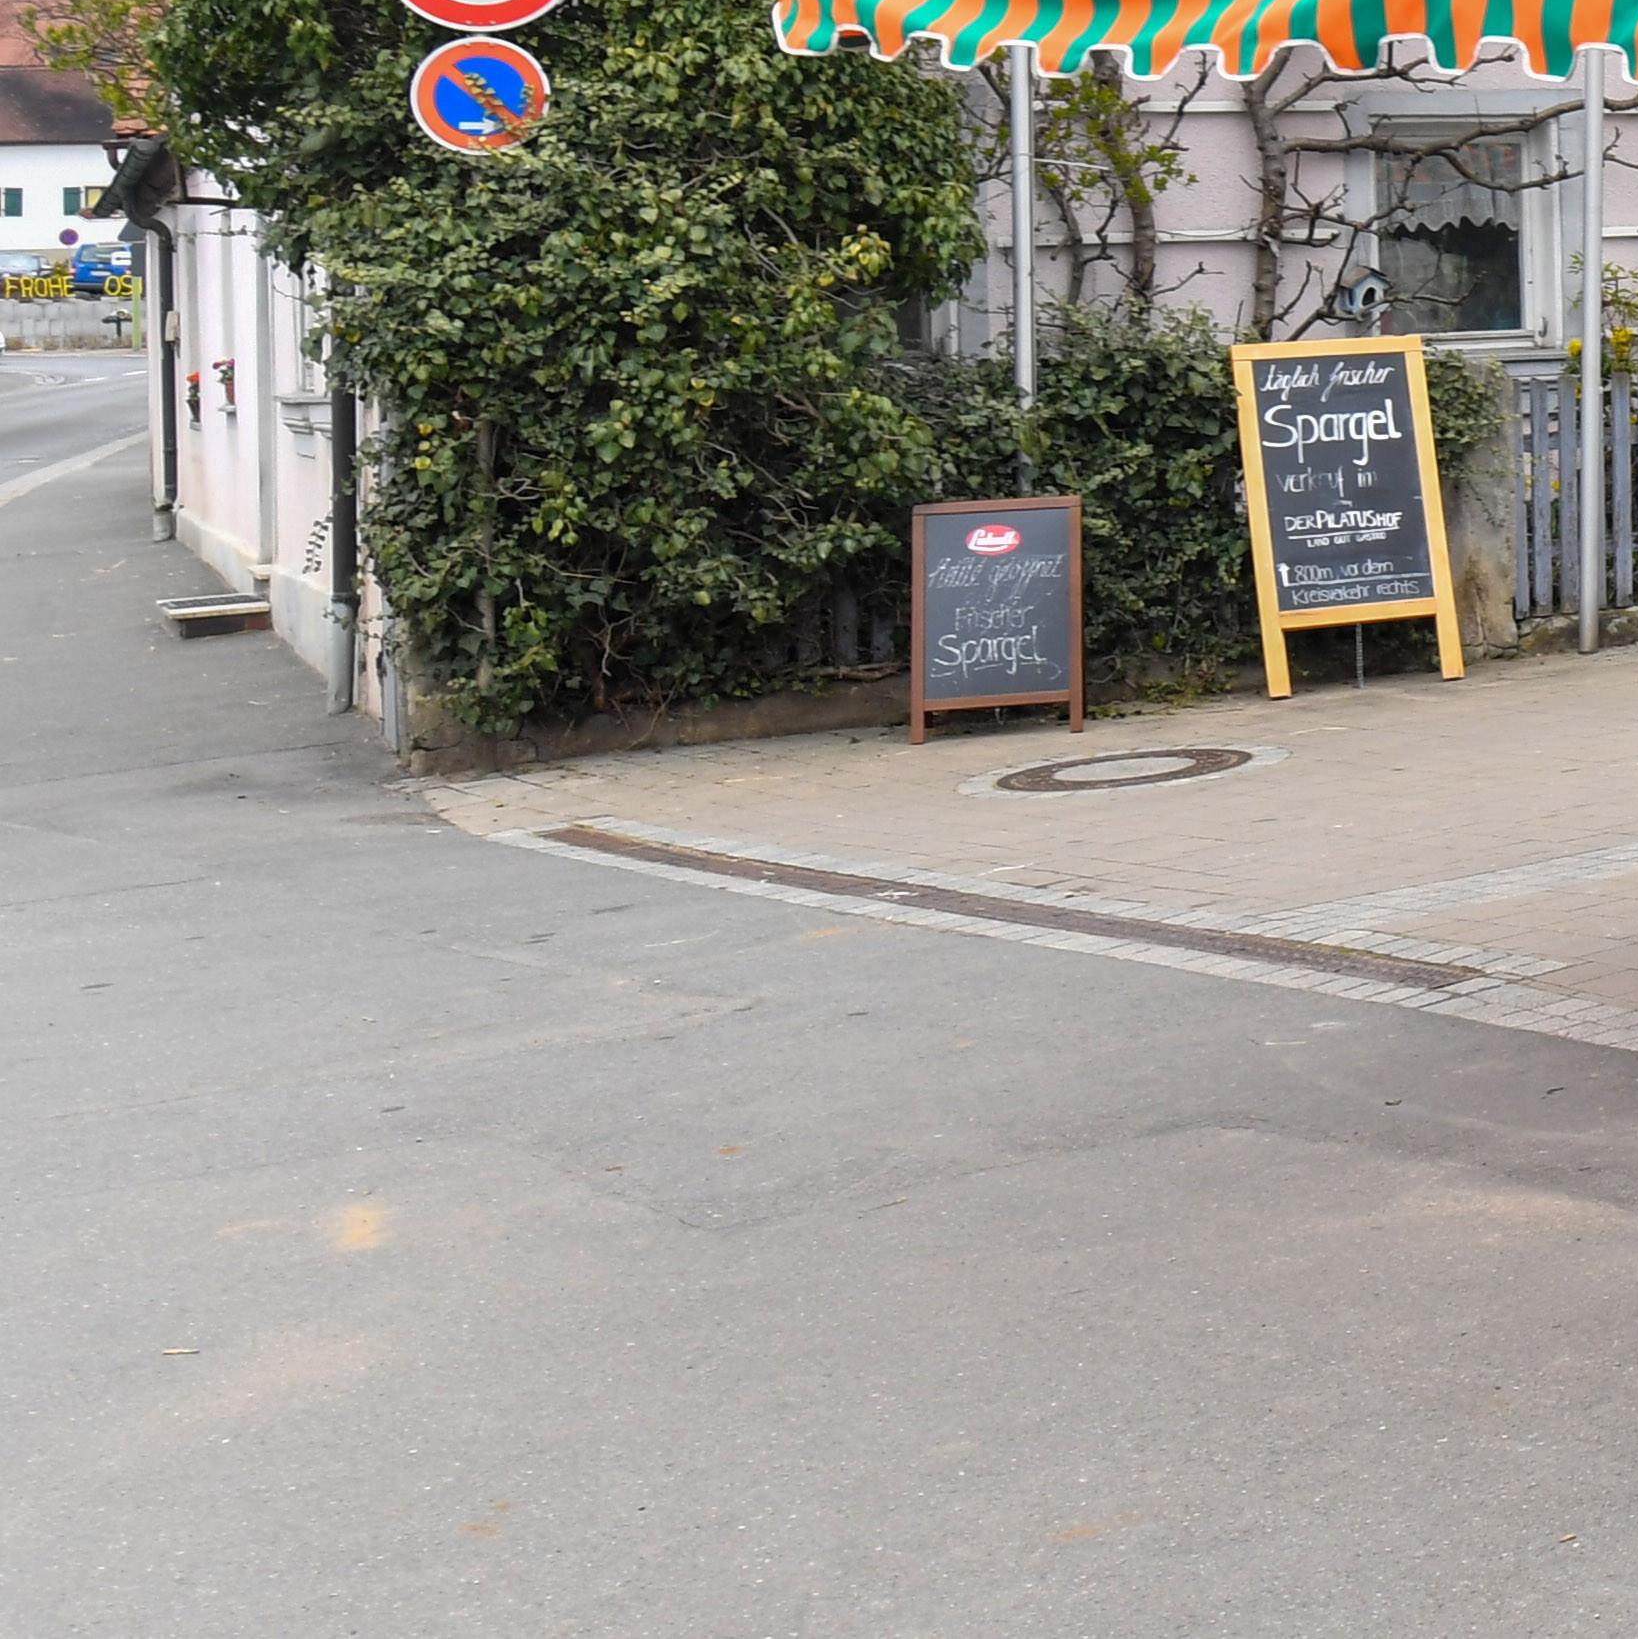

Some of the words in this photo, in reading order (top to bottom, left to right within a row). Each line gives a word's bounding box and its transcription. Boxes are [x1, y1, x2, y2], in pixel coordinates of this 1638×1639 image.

[5, 274, 76, 299] FROHE
[1260, 363, 1320, 401] täglich
[1320, 360, 1396, 402] frischer
[1262, 398, 1402, 466] Spargel
[933, 625, 1048, 679] Spargel
